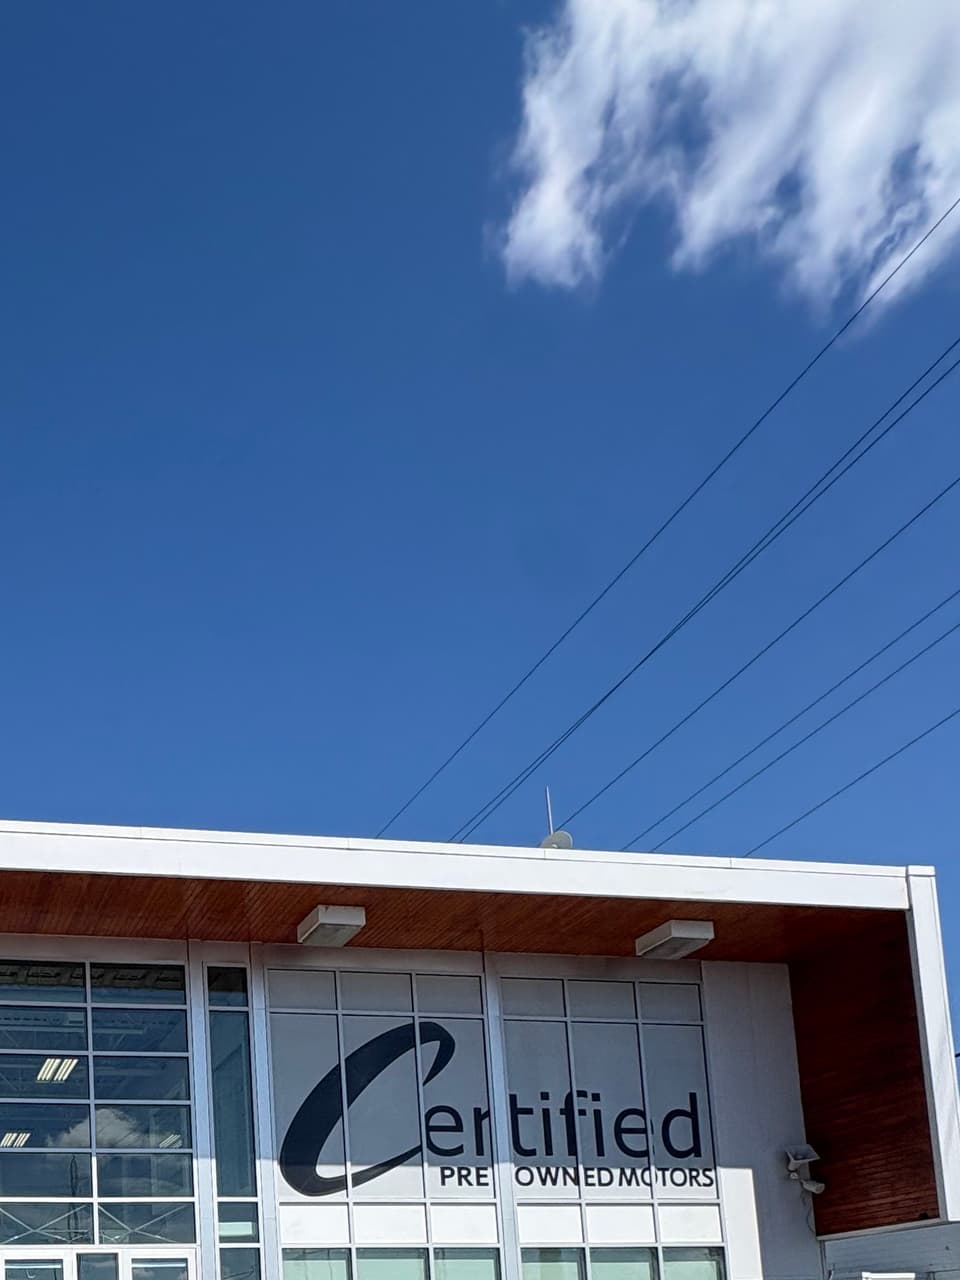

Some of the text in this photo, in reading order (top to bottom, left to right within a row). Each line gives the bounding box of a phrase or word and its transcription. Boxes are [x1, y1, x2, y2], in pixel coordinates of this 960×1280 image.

[279, 1021, 701, 1197] Certified
[515, 1167, 614, 1187] OWNED
[618, 1167, 714, 1187] MOTORS
